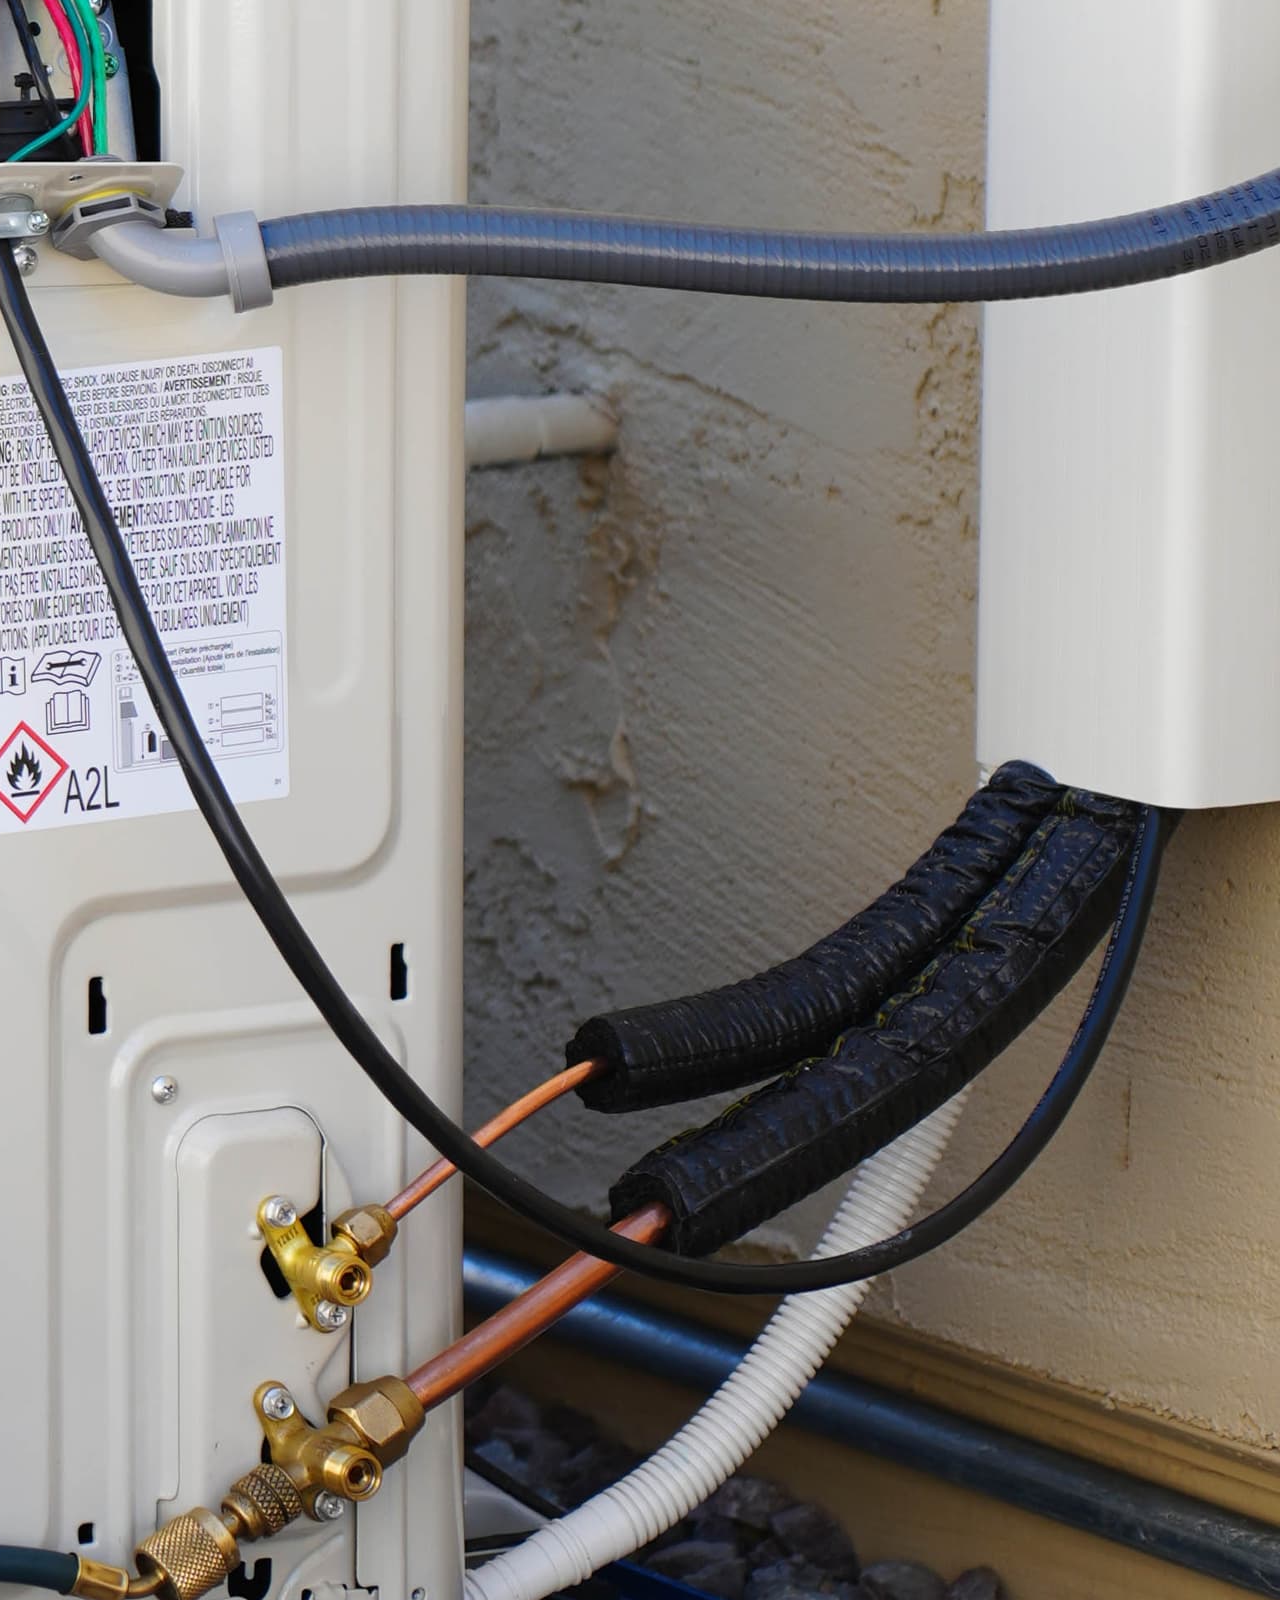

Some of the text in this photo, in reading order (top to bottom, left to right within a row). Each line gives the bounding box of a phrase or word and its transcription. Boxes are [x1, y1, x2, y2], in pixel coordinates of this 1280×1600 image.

[93, 387, 119, 400] BEFORE
[238, 371, 263, 384] RISQUE
[101, 373, 114, 385] CAN
[116, 370, 139, 384] CAUSE
[141, 367, 163, 381] INJURY
[166, 366, 176, 378] OR
[203, 359, 245, 374] DISCONNECT
[90, 415, 122, 430] DISTANCE
[124, 412, 145, 426] AVANT
[147, 411, 159, 423] LES
[94, 402, 107, 415] DES
[109, 398, 148, 413] BLESSURES
[150, 396, 160, 409] OU
[162, 395, 169, 407] LA
[244, 384, 270, 398] TOUTES
[10, 464, 19, 486] BE
[21, 459, 60, 485] INSTALLED
[132, 448, 156, 473] OTHER
[159, 446, 178, 470] THAN
[179, 442, 215, 467] AUXILIARY
[217, 438, 247, 463] DEVICES
[249, 435, 274, 459] LISTED
[17, 438, 35, 462] RISK
[36, 436, 46, 459] OF
[109, 426, 141, 451] DEVICES
[142, 423, 166, 447] WHICH
[168, 421, 183, 445] MAY
[185, 420, 194, 443] BE
[195, 416, 227, 441] IGNITION
[228, 412, 263, 438] SOURCES
[3, 490, 21, 514] WITH
[24, 489, 37, 512] THE
[116, 478, 131, 501] SEE
[236, 464, 251, 488] FOR
[2, 516, 41, 542] PRODUCTS
[221, 493, 234, 516] LES
[24, 516, 274, 567] AUXILIAIRES DES SOURCES NE
[5, 573, 19, 596] PAS
[81, 564, 101, 588] DANS
[159, 555, 179, 578] SAUF
[199, 550, 218, 574] SONT
[24, 572, 258, 621] COMME POUR CET VOIR LES
[79, 618, 99, 643] POUR
[101, 616, 115, 640] LES
[154, 606, 198, 634] TUBULAIRES
[63, 764, 120, 813] A2L
